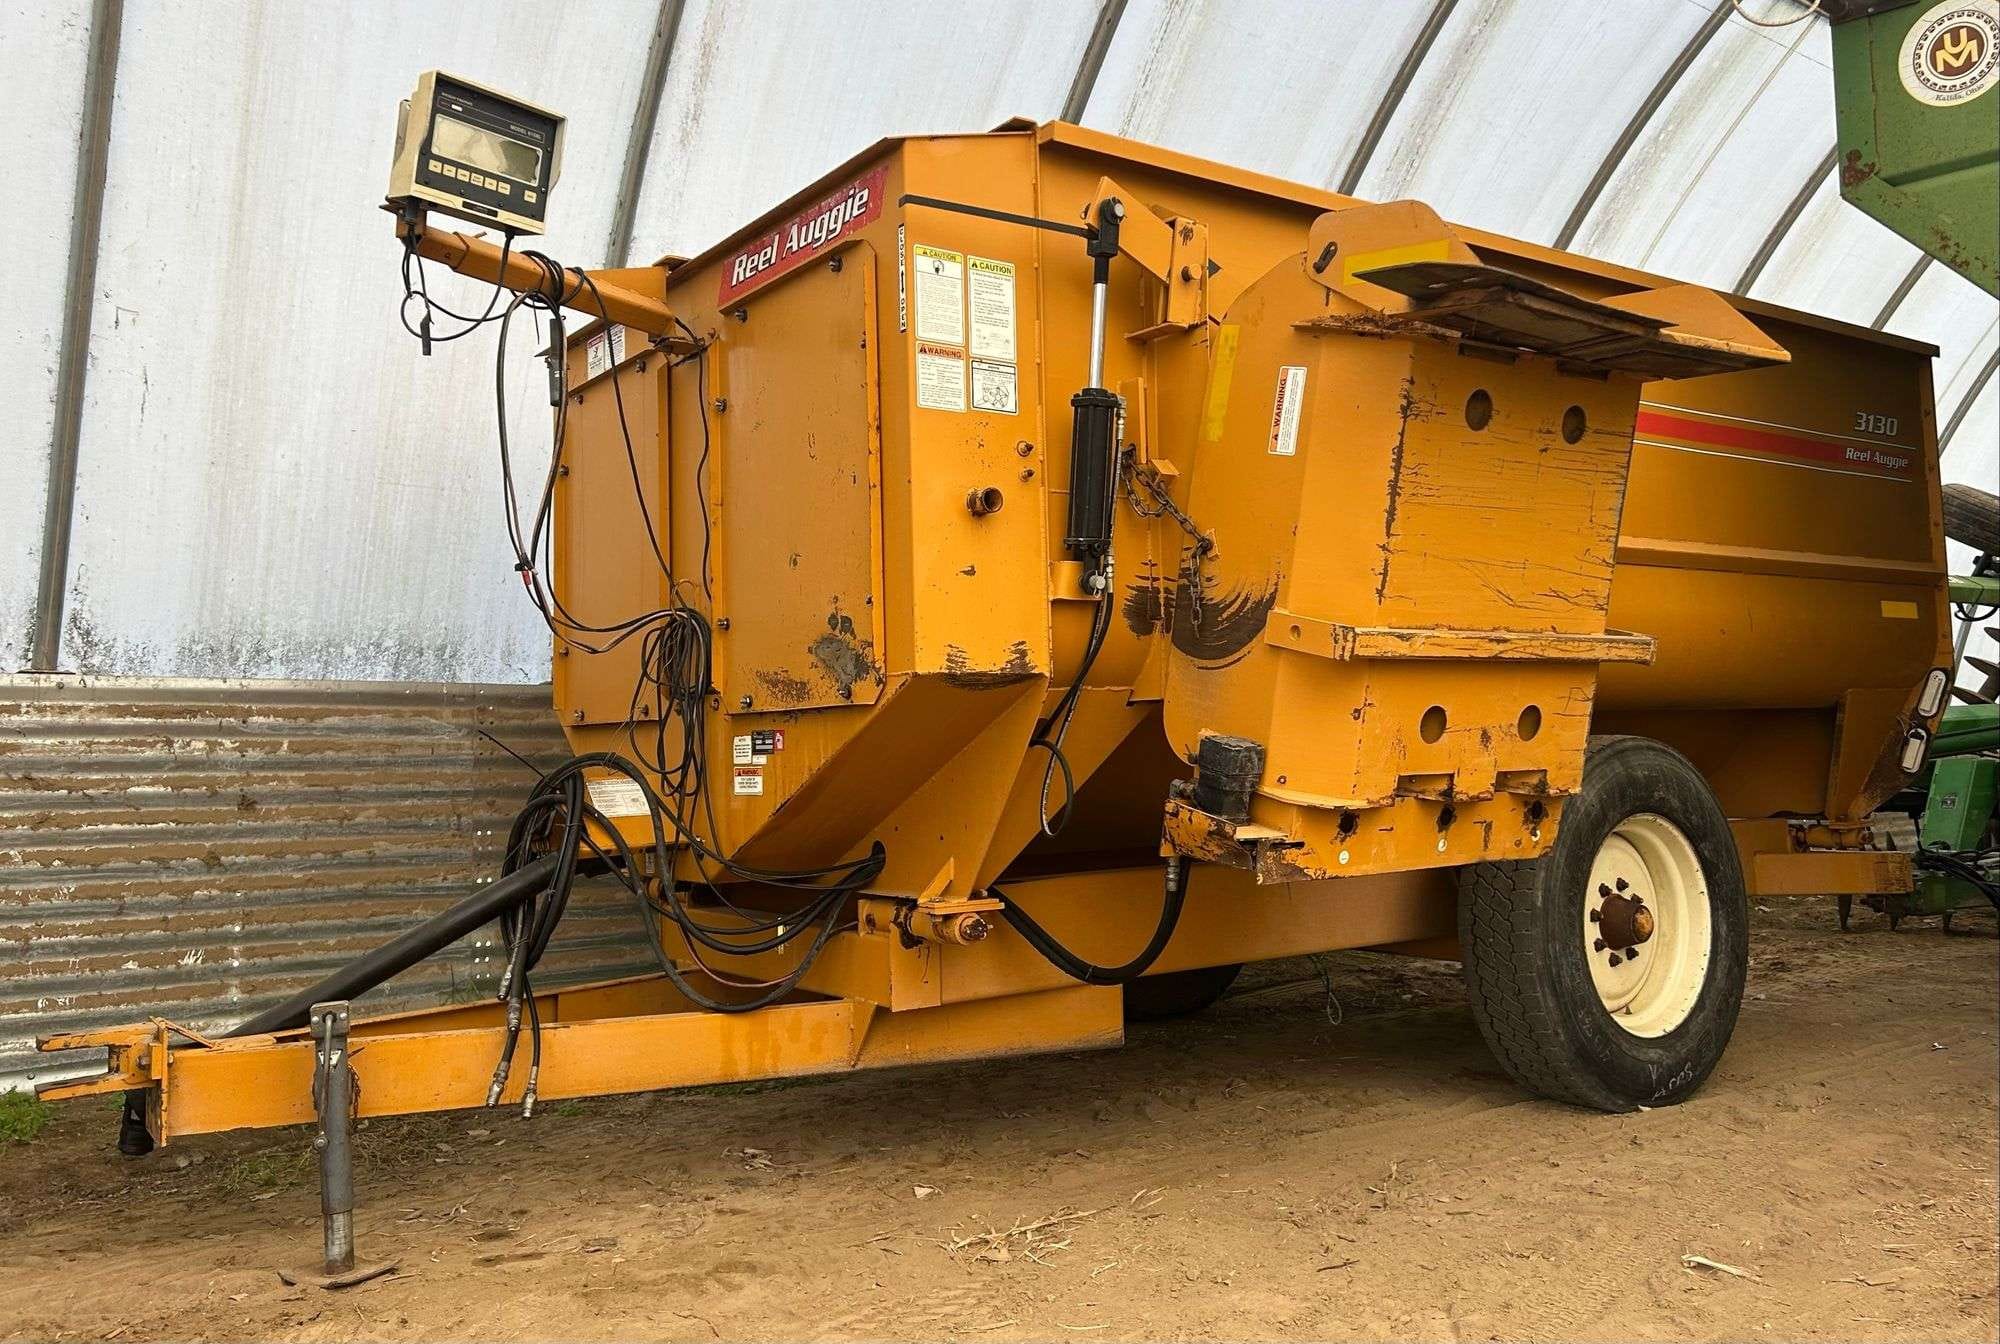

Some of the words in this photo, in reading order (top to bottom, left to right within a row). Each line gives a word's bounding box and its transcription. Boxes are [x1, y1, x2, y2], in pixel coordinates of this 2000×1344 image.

[1965, 83, 1985, 97] Ohio
[731, 233, 780, 287] Reel
[782, 187, 870, 259] Auggie
[929, 251, 957, 261] CAUTION
[979, 262, 1012, 275] CAUTION
[928, 347, 962, 358] WARNING
[1273, 378, 1287, 427] WARNING
[1854, 412, 1898, 436] 3130
[1846, 447, 1870, 462] Reel
[1872, 451, 1909, 469] Auggie
